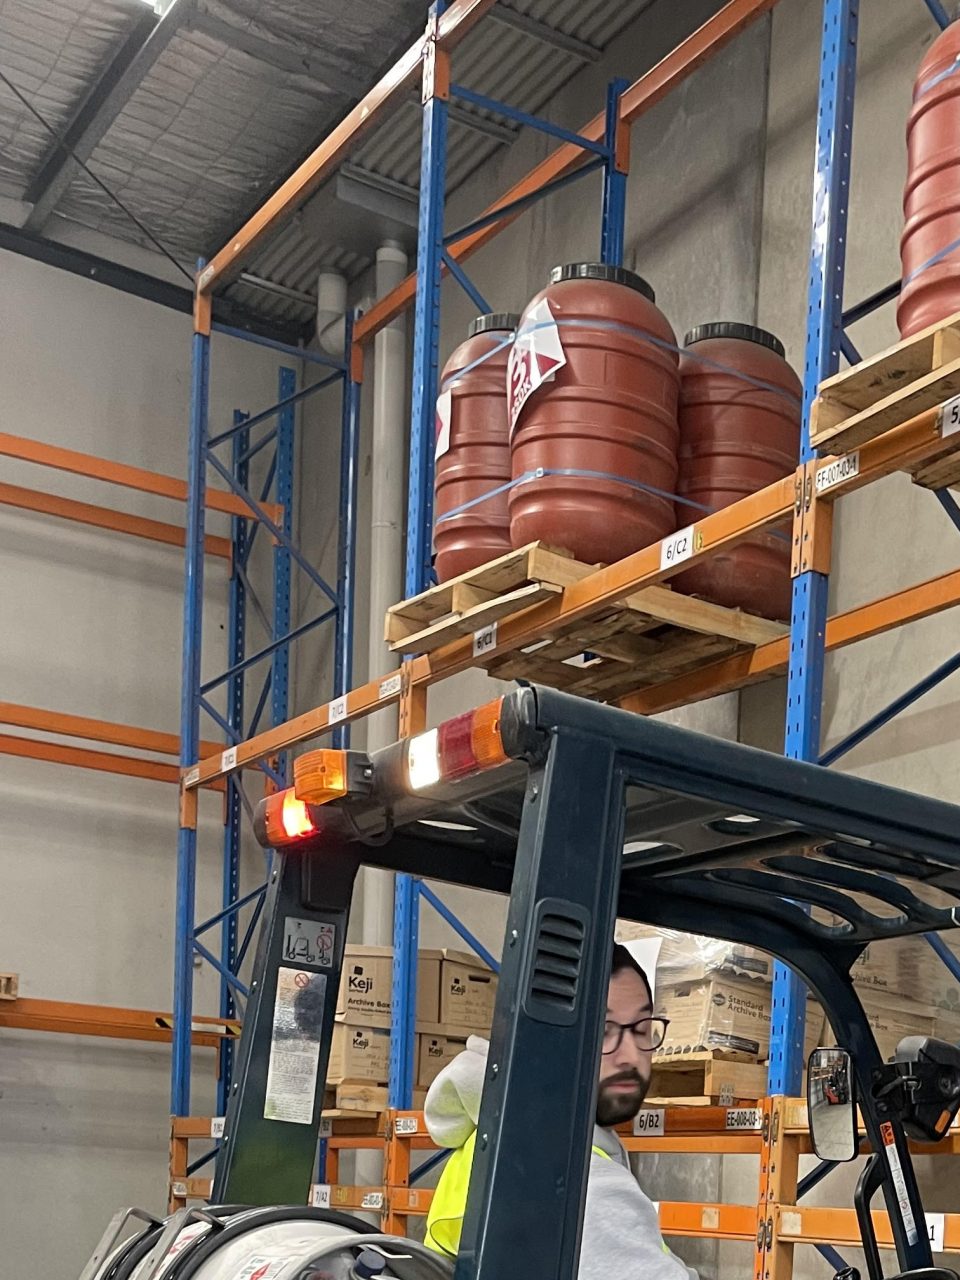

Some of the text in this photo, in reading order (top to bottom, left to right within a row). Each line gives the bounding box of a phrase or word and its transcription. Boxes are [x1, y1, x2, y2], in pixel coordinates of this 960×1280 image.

[666, 538, 687, 560] 6/C2
[349, 976, 373, 994] Keji
[451, 985, 466, 996] Keji
[348, 998, 391, 1009] Archive Box
[728, 995, 764, 1012] Standard
[728, 1003, 757, 1018] Archive
[353, 1038, 369, 1050] Keji
[639, 1113, 660, 1131] 6/B2
